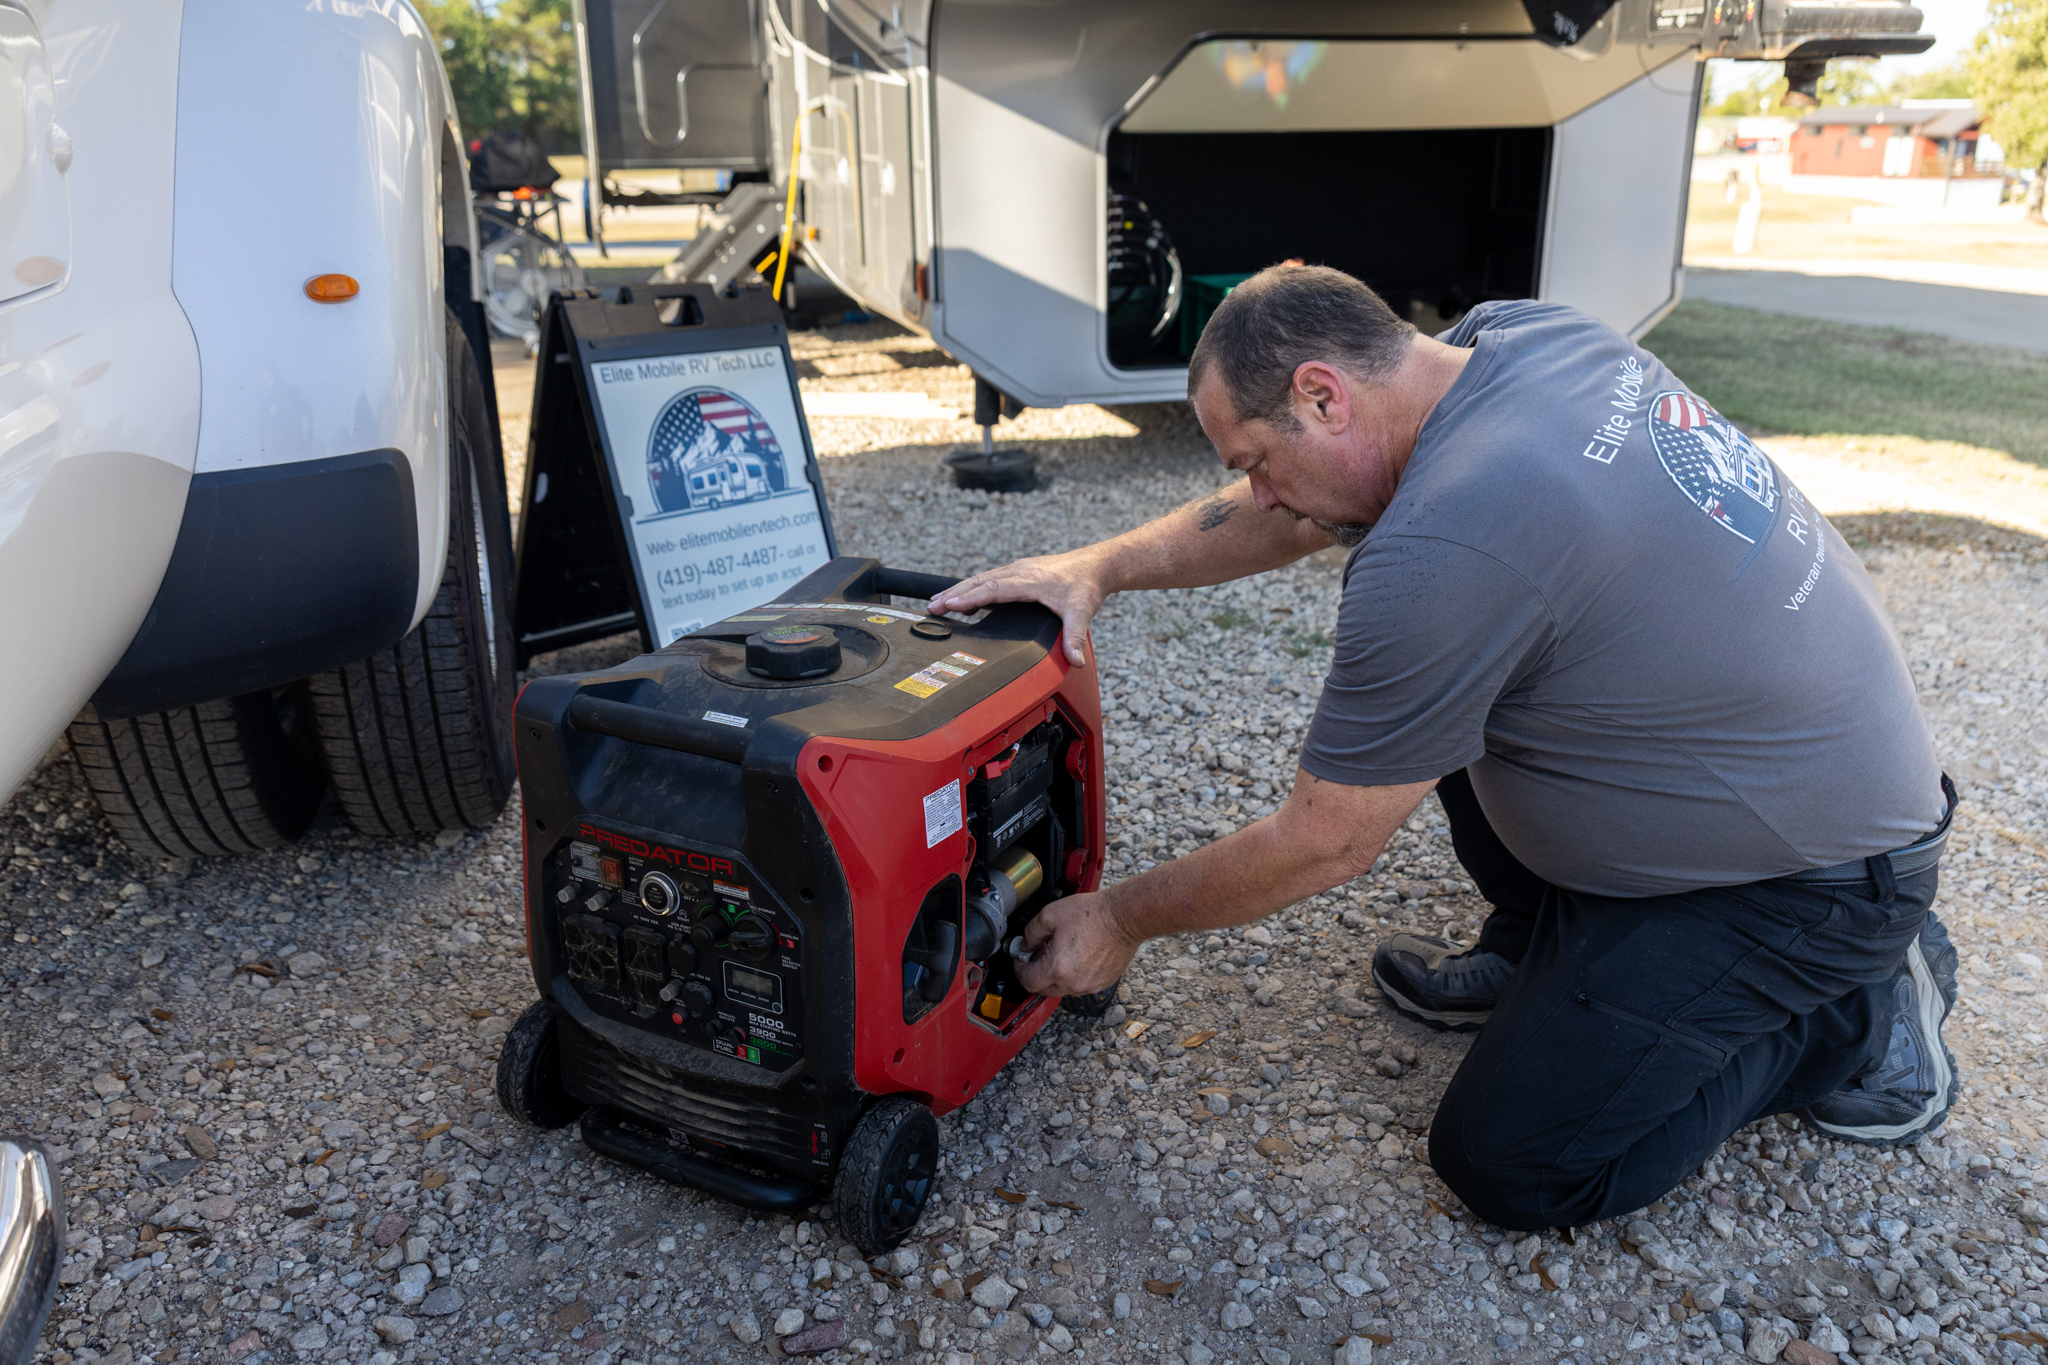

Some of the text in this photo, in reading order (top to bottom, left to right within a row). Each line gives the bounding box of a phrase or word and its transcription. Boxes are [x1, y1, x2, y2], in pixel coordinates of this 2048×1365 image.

[600, 351, 776, 384] Elite Mobile RV Tech LLC
[1583, 356, 1643, 465] Elite Mobile
[1786, 478, 1809, 546] RV Te
[787, 544, 804, 559] call
[806, 544, 816, 555] or
[661, 590, 683, 610] text
[685, 585, 717, 608] today
[718, 582, 730, 596] to
[731, 578, 748, 593] set
[750, 575, 764, 590] up
[766, 572, 779, 584] an
[1784, 562, 1822, 611] Veteran
[925, 781, 958, 803] PREDATOR
[579, 823, 734, 876] PREDATOR
[748, 1012, 784, 1029] 5000
[749, 1026, 776, 1039] 3900
[759, 1023, 781, 1033] STARTING
[781, 1030, 797, 1038] WATTS
[715, 1038, 735, 1050] DUAL
[716, 1044, 735, 1054] FUEL
[812, 1159, 830, 1167] UNLOCK
